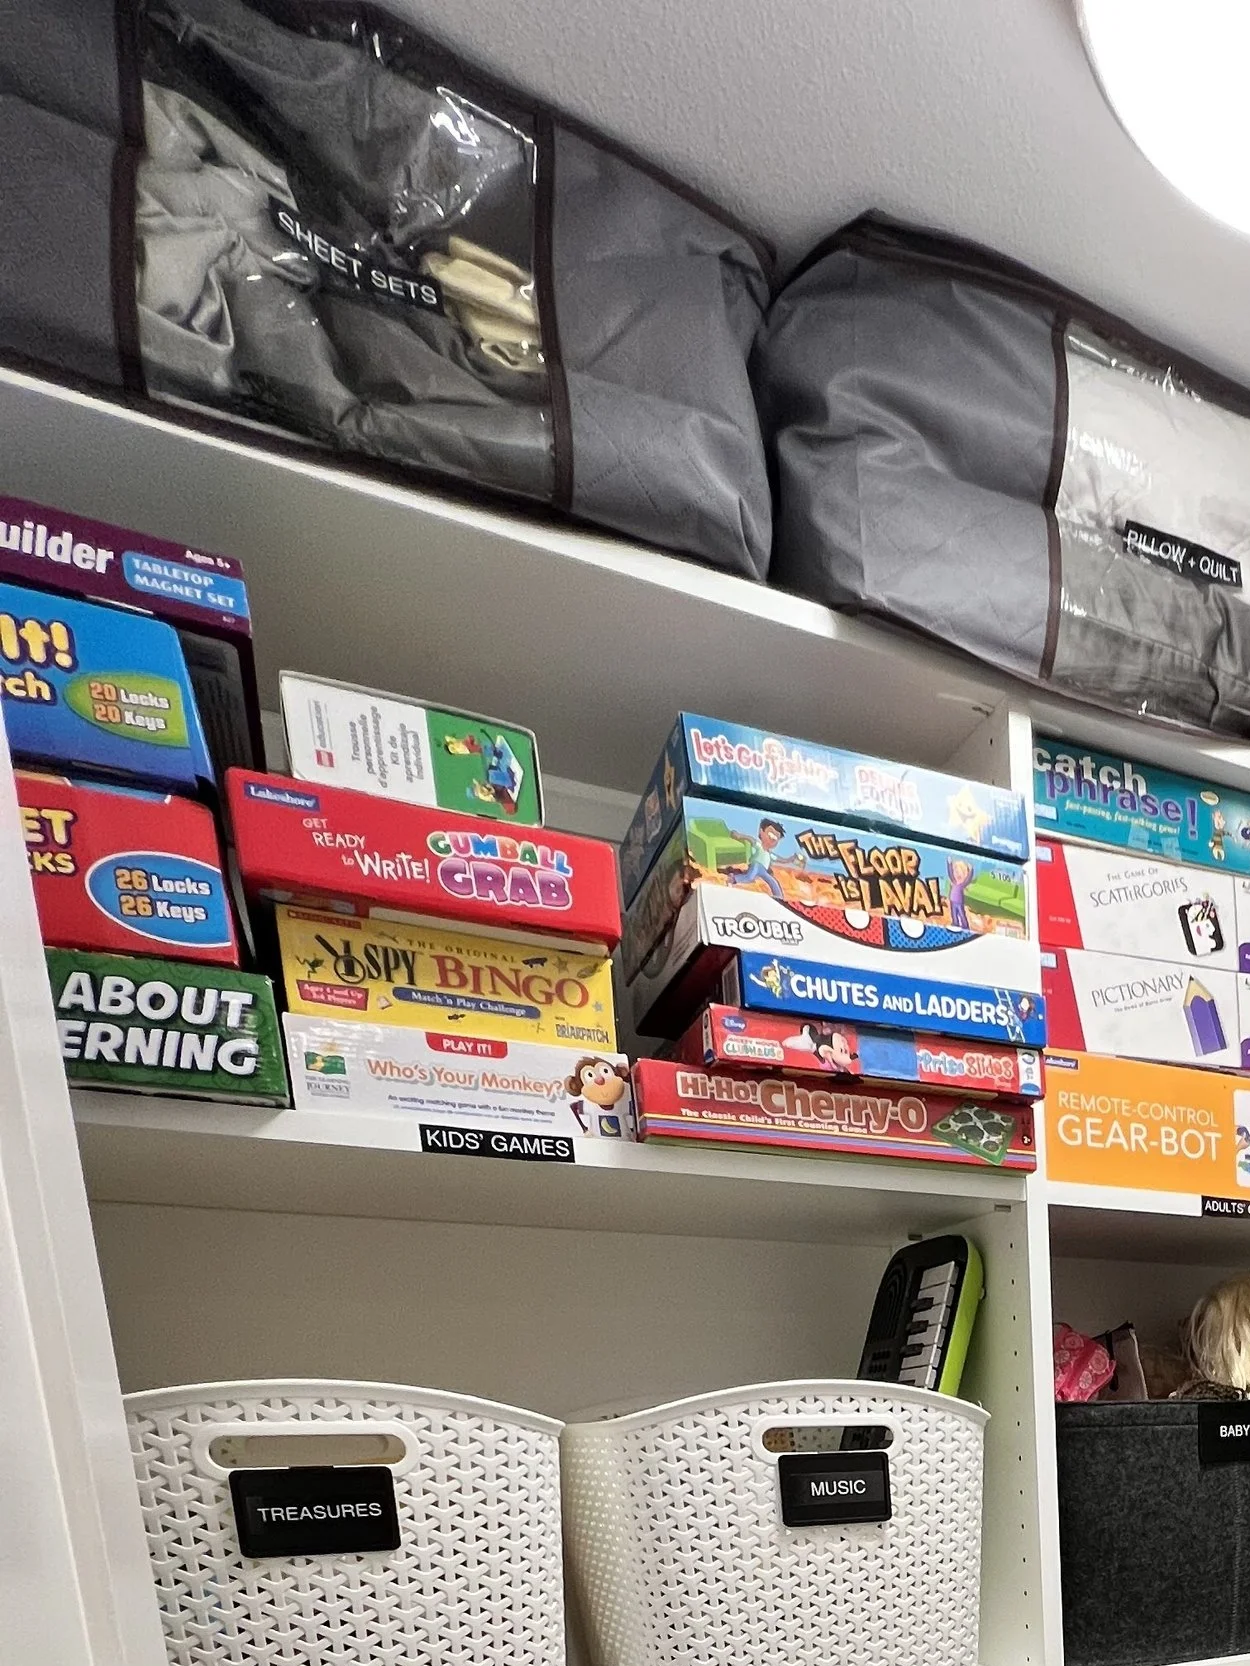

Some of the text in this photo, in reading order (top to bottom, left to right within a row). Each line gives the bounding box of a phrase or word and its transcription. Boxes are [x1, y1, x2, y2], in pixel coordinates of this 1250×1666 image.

[278, 211, 438, 306] SHEET SETS
[131, 557, 215, 588] TABLETOP
[1127, 529, 1240, 584] PILLOW + QUILT
[133, 573, 236, 609] MAGNET SET
[0, 670, 52, 702] ch
[90, 682, 170, 711] 20 Locks
[94, 703, 167, 732] 20 Keys
[690, 728, 765, 770] Let's Go
[1033, 747, 1149, 799] catch
[249, 785, 316, 809] Lakeshore
[1044, 767, 1199, 841] phrase!
[302, 817, 329, 829] GET
[312, 831, 366, 850] READY
[426, 830, 574, 877] GUMBALL
[798, 831, 837, 856] THE
[28, 851, 76, 875] KS
[341, 853, 354, 866] to
[837, 840, 921, 880] FLOOR
[115, 868, 212, 897] 26 Locks
[437, 857, 573, 912] GRAB
[856, 877, 943, 916] LAVA!
[1089, 876, 1189, 909] SCATTERGORIES
[119, 895, 208, 924] 26 Keys
[713, 912, 804, 944] TROUBLE
[363, 942, 418, 987] SPY
[408, 938, 517, 964] THE ORIGINAL
[429, 954, 590, 1010] BINGO
[1091, 972, 1186, 1009] PICTIONARY
[58, 970, 253, 1029] ABOUT
[411, 990, 443, 1005] Match
[456, 996, 477, 1011] Play
[478, 1000, 527, 1017] Challenge
[788, 974, 1015, 1027] CHUTES AND LADDERS
[442, 1038, 493, 1056] PLAY IT!
[306, 1081, 351, 1093] JOURNEY
[366, 1059, 564, 1100] Who's Your Monkey?
[676, 1071, 928, 1138] Hi-Ho! Cherry-O
[680, 1108, 700, 1118] The
[701, 1110, 737, 1121] Classic
[738, 1113, 773, 1126] Child's
[774, 1117, 797, 1128] First
[797, 1120, 840, 1133] Counting
[1057, 1090, 1219, 1128] REMOTE-CONTROL
[425, 1128, 571, 1158] KIDS' GAMES
[1057, 1114, 1223, 1162] GEAR-BOT
[1204, 1199, 1247, 1216] ADULTS'
[1219, 1423, 1250, 1438] BABY
[809, 1479, 867, 1497] MUSIC
[256, 1502, 383, 1523] TREASURES
